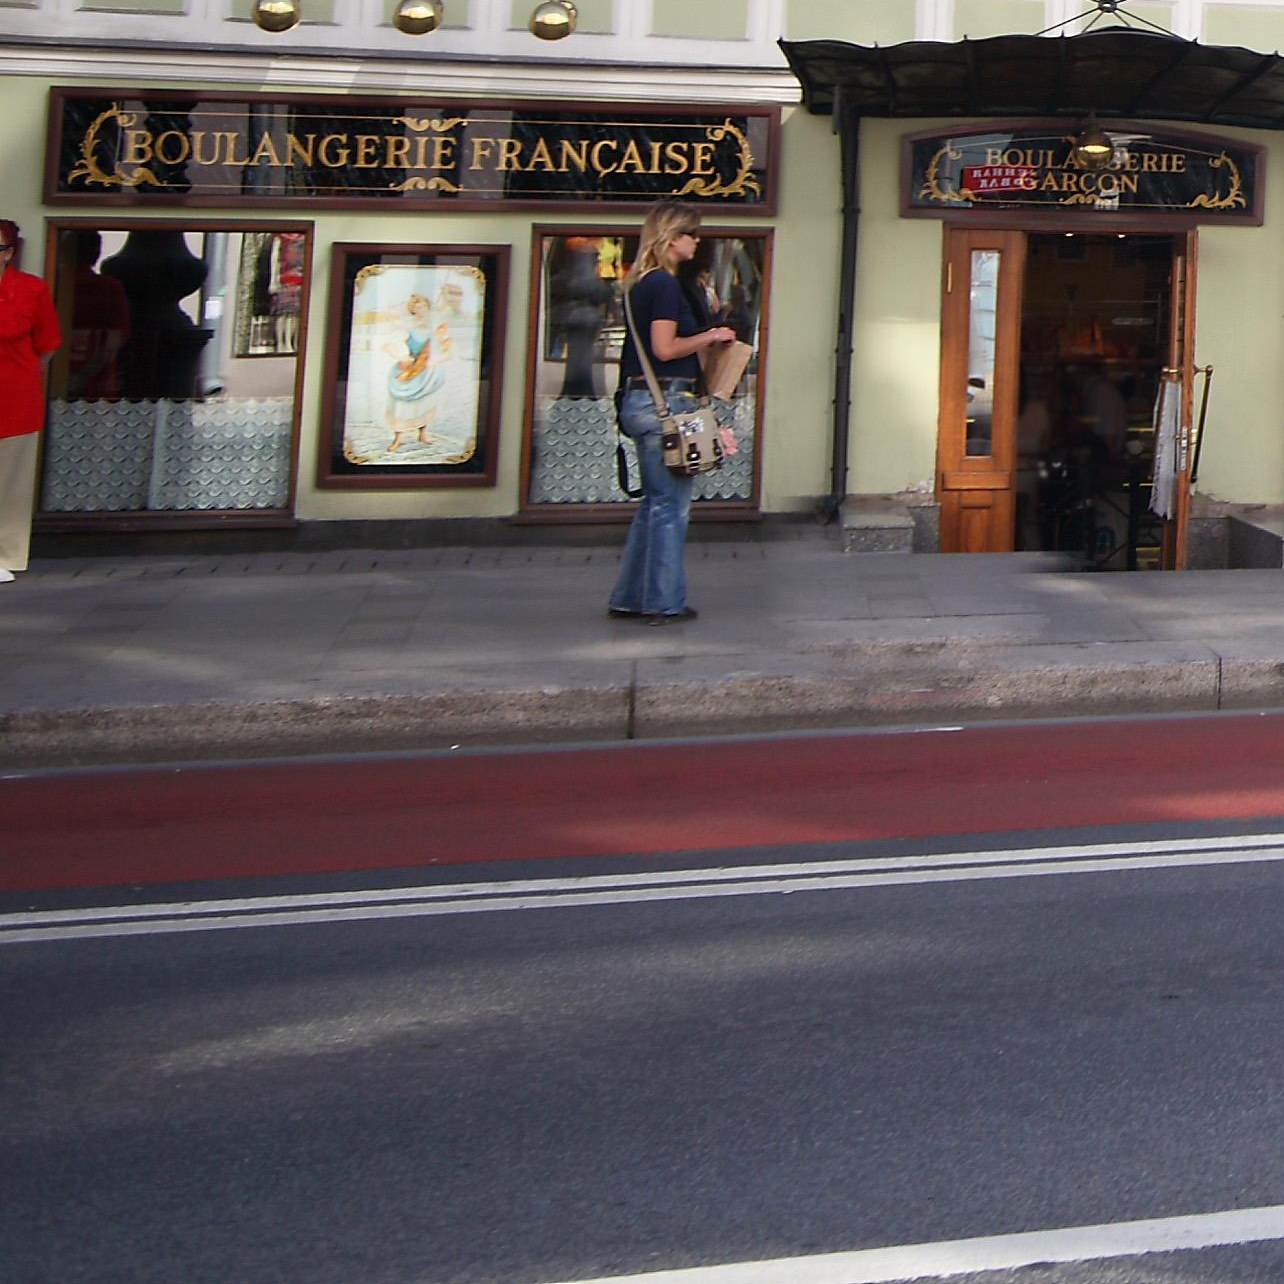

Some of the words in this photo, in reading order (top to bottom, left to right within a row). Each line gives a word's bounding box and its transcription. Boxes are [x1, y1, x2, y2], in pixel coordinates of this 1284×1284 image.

[123, 128, 456, 171] BOULANGERIE
[471, 133, 716, 180] FRANÇAISE
[985, 147, 1187, 173] BOULAGERIE
[1020, 172, 1139, 196] GARÇON
